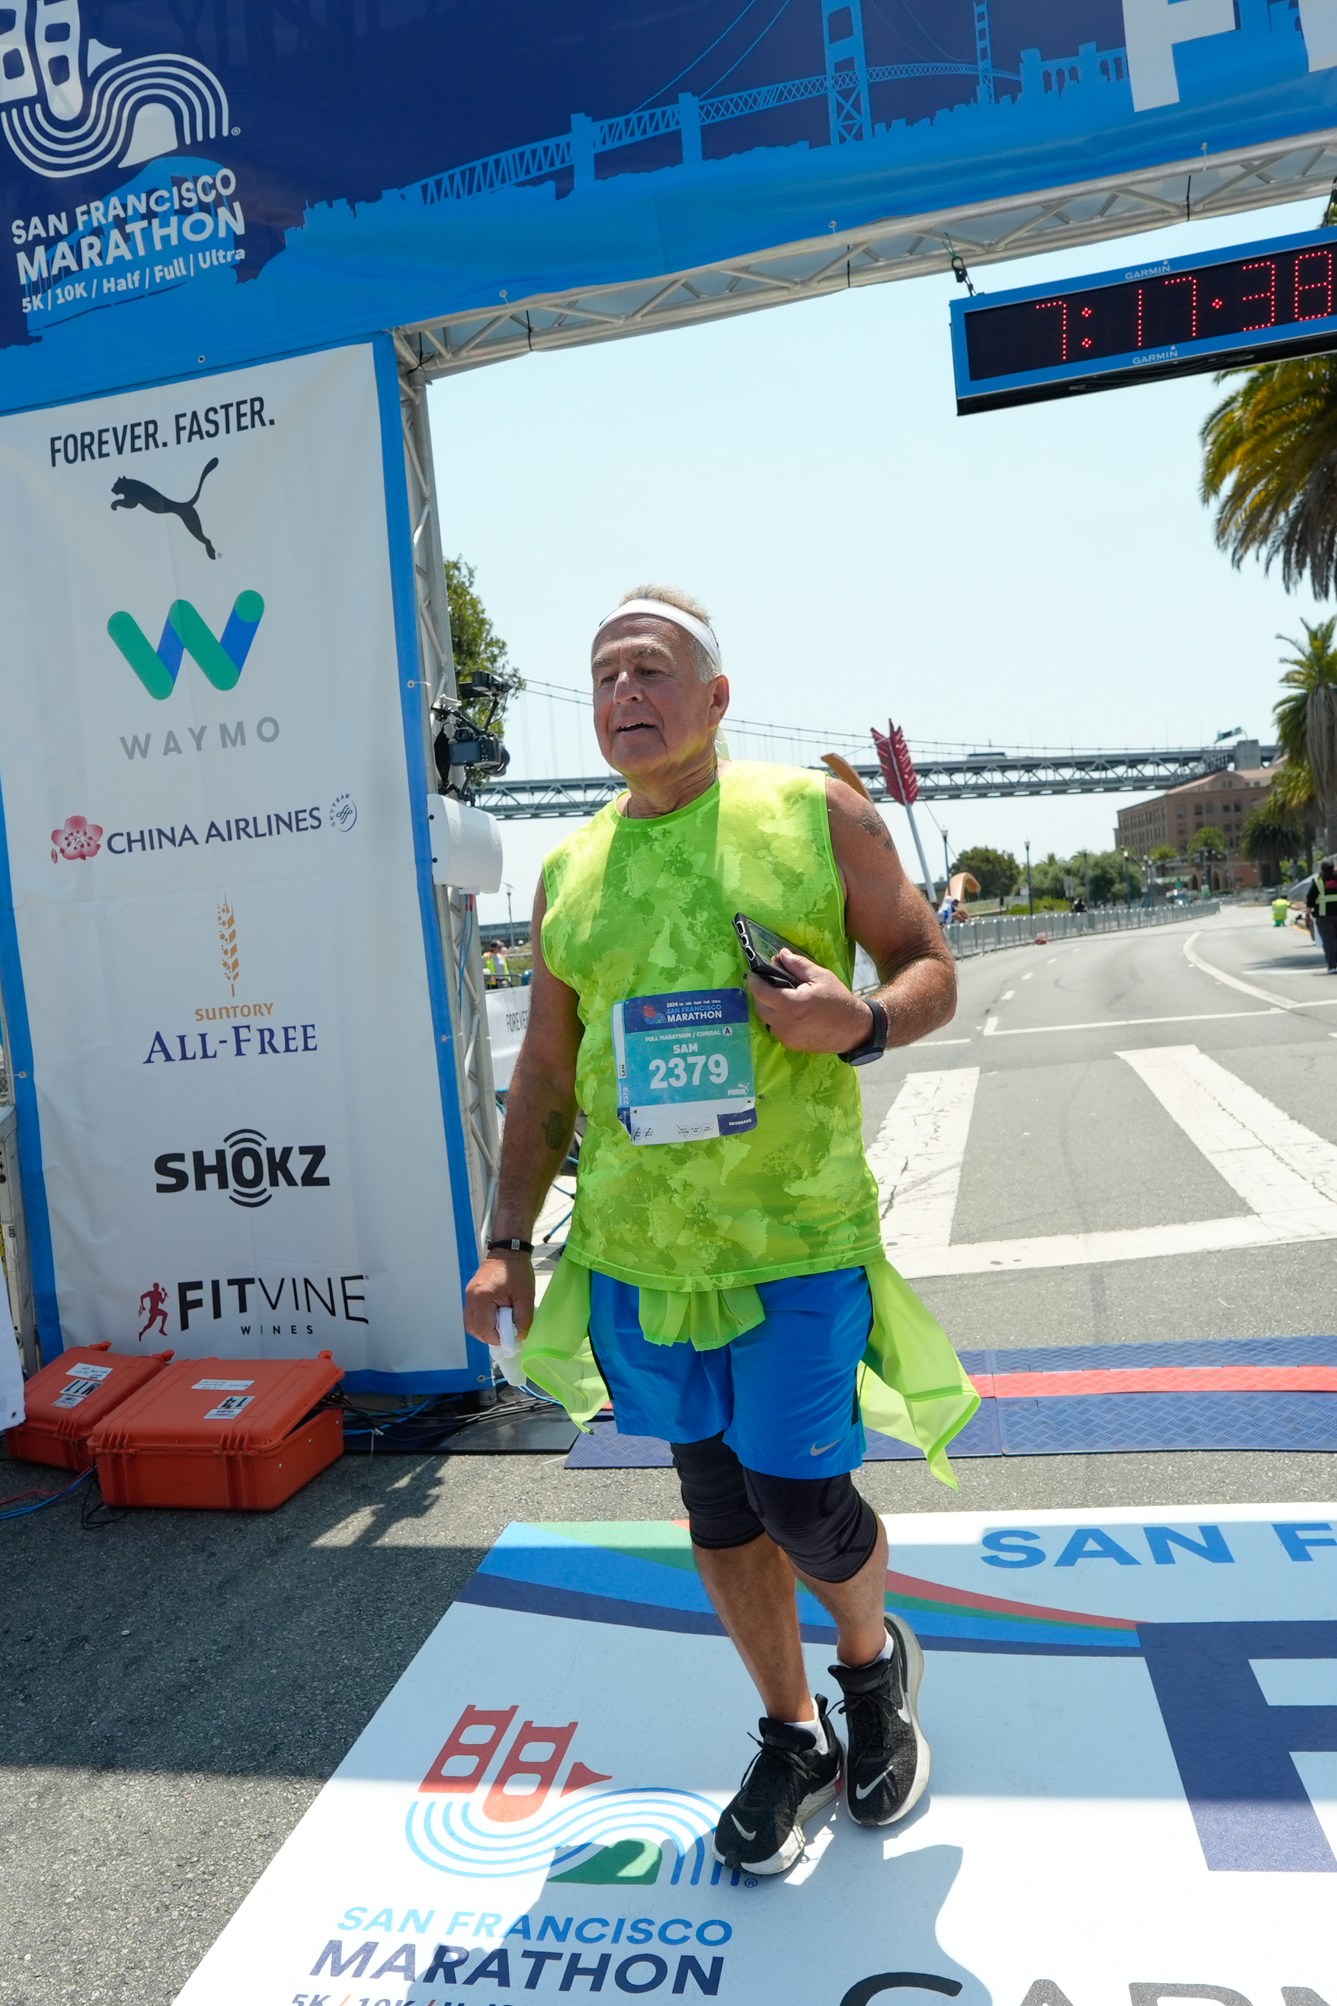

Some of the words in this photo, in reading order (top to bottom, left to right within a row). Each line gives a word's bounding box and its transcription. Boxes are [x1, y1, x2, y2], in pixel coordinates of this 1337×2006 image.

[11, 212, 69, 245] SAN
[75, 167, 237, 231] FRANCISCO
[16, 200, 246, 285] MARATHON
[21, 294, 46, 314] 5K
[55, 281, 89, 305] 10K
[102, 267, 141, 295] Half
[154, 256, 188, 284] Full
[198, 245, 246, 270] Ultra
[1124, 264, 1171, 281] GARMIN
[1132, 349, 1179, 366] GARMIN
[50, 418, 168, 468] FOREVER.
[174, 396, 276, 446] FASTER.
[119, 716, 280, 761] WAYMO
[106, 824, 200, 855] CHINA
[205, 806, 323, 845] AIRLINES
[666, 1007, 680, 1015] SAN
[681, 1004, 722, 1013] FRANCISCO
[667, 1010, 722, 1023] MARATHON
[660, 1032, 692, 1041] MARATHON
[673, 1043, 699, 1055] SAM
[648, 1053, 729, 1090] 2379
[154, 1144, 330, 1194] SHOKZ
[177, 1274, 370, 1332] FITVINE
[240, 1324, 314, 1336] WINES
[980, 1524, 1236, 1569] SAN
[337, 1905, 435, 1936] SAN
[445, 1909, 734, 1948] FRANCISCO
[310, 1939, 726, 1997] MARATHON
